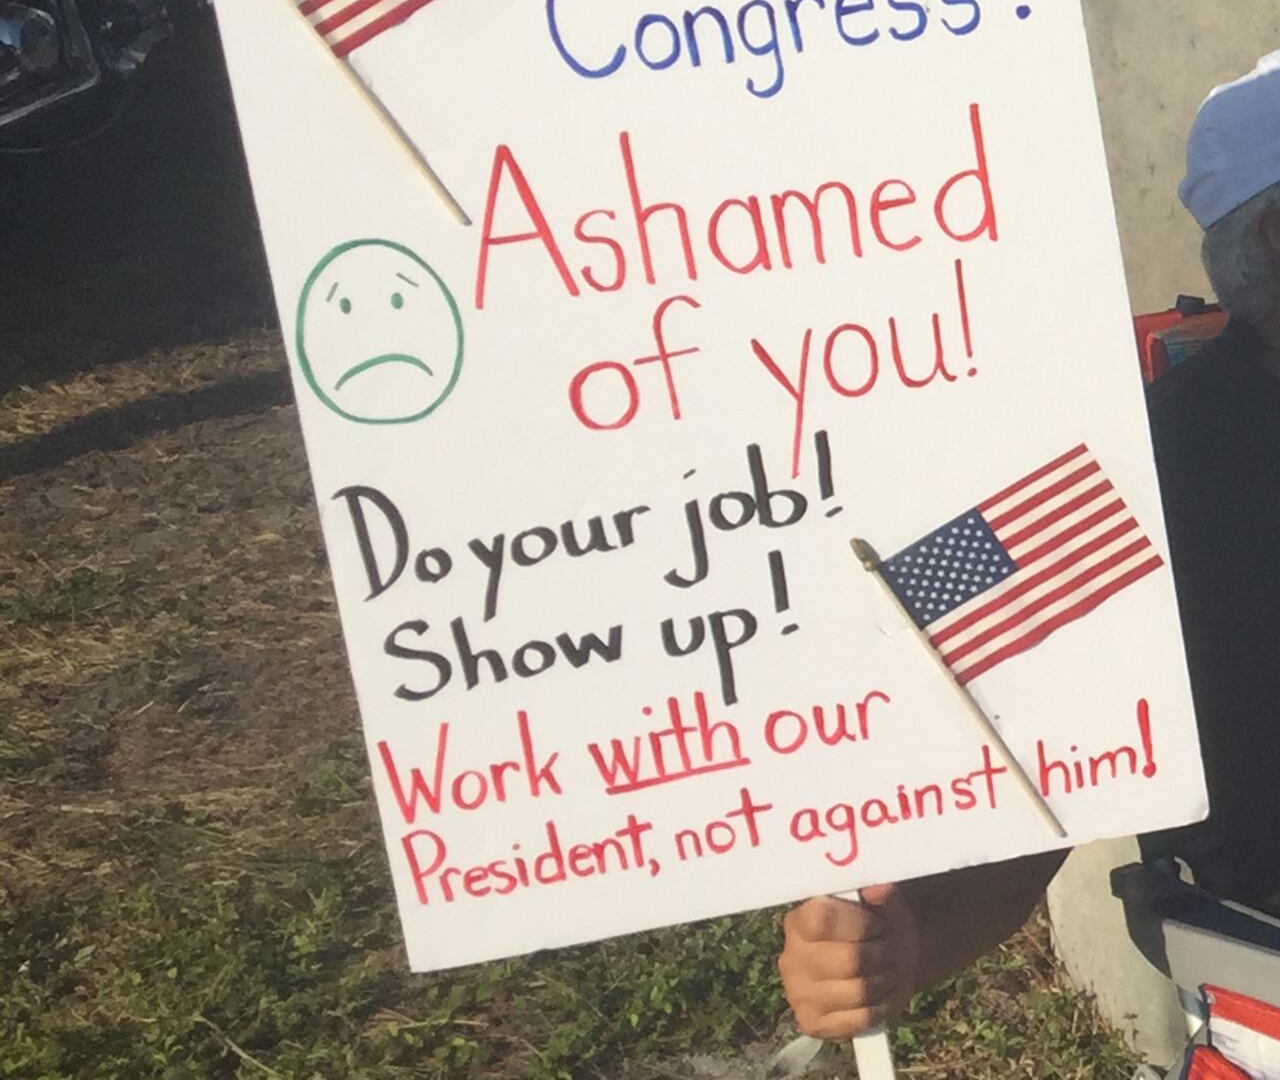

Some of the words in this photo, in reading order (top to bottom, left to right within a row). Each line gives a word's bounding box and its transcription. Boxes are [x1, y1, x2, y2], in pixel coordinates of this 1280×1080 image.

[474, 103, 1000, 308] Ashamed
[568, 295, 701, 431] of
[750, 258, 978, 479] you!
[332, 484, 452, 602] Do
[467, 501, 650, 622] your
[664, 430, 844, 588] job!
[383, 620, 622, 702] Show
[662, 550, 802, 706] up!
[377, 711, 563, 823] Work
[589, 692, 751, 795] with
[764, 687, 891, 757] our
[400, 815, 661, 905] President,
[675, 788, 773, 862] not
[789, 745, 1008, 866] against
[1036, 698, 1159, 799] him!
